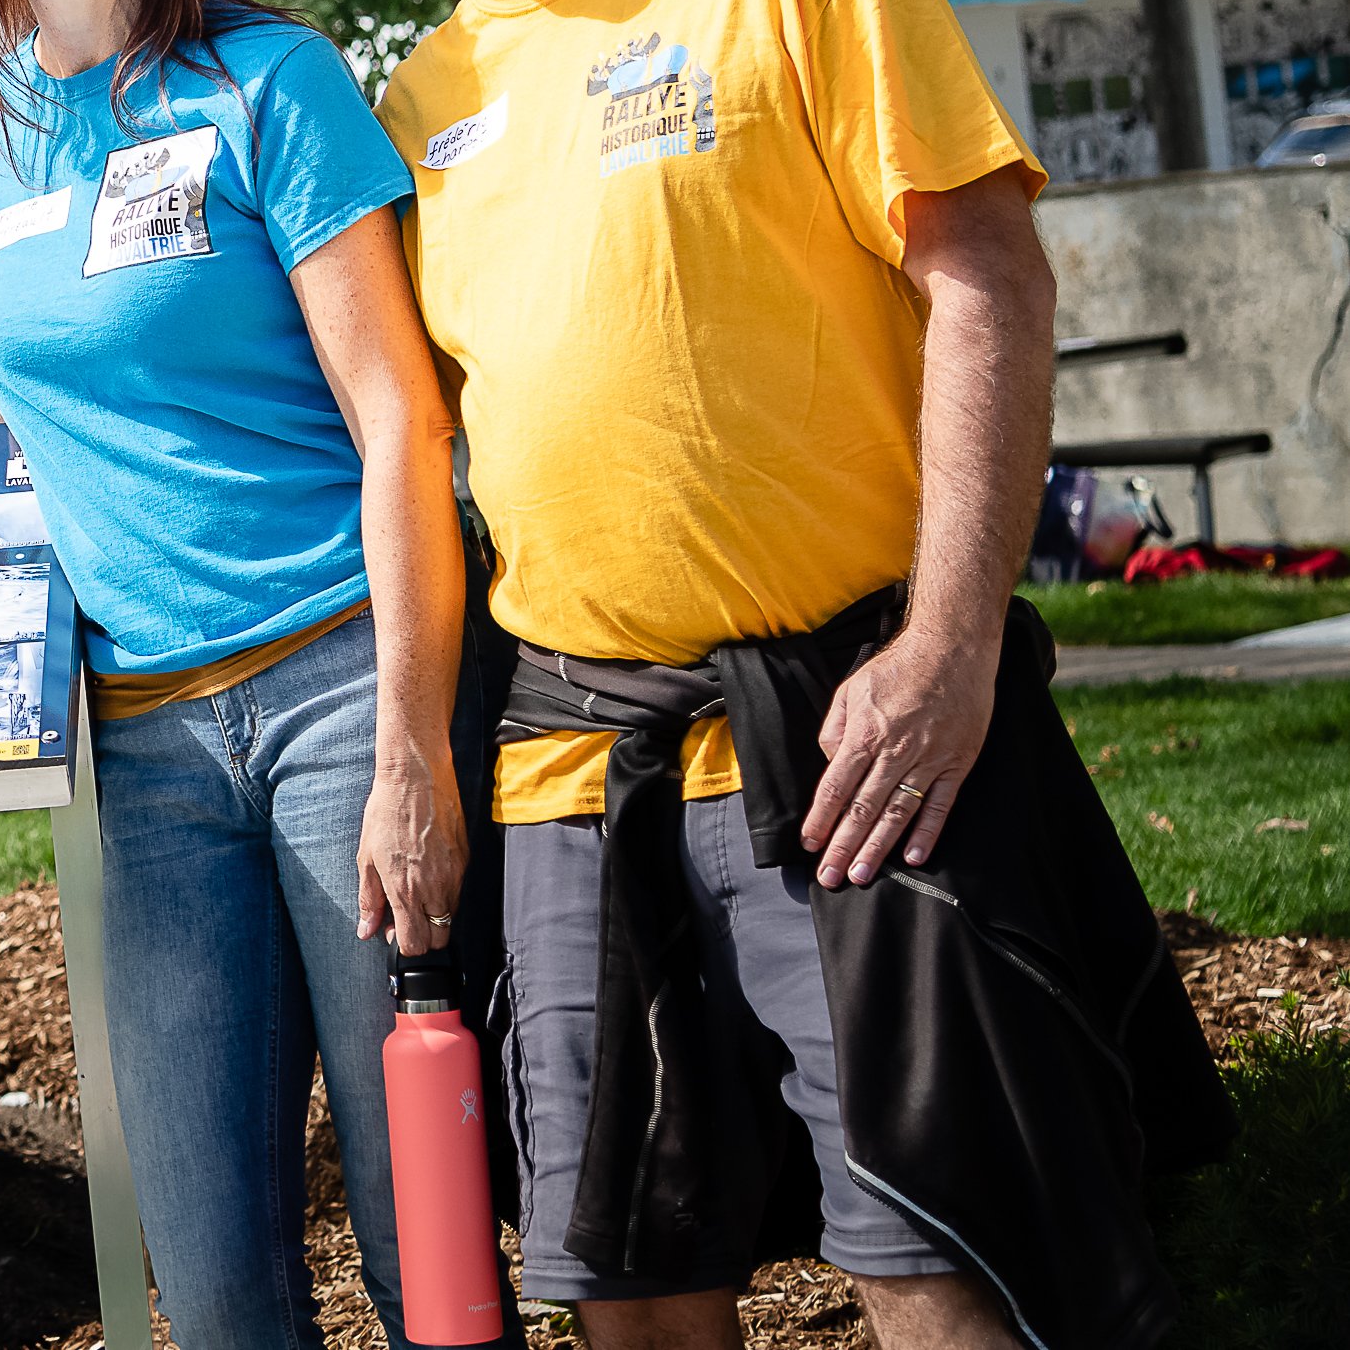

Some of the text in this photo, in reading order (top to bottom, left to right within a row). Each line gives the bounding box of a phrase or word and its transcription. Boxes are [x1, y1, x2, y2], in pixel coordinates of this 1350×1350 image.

[603, 82, 687, 130] RALLYE
[601, 113, 688, 155] HISTORIQUE
[600, 133, 689, 178] LAVALTRIE
[112, 189, 180, 227] RALLYE
[108, 234, 186, 266] LAVALTRIE
[111, 218, 182, 249] HISTORIQUE
